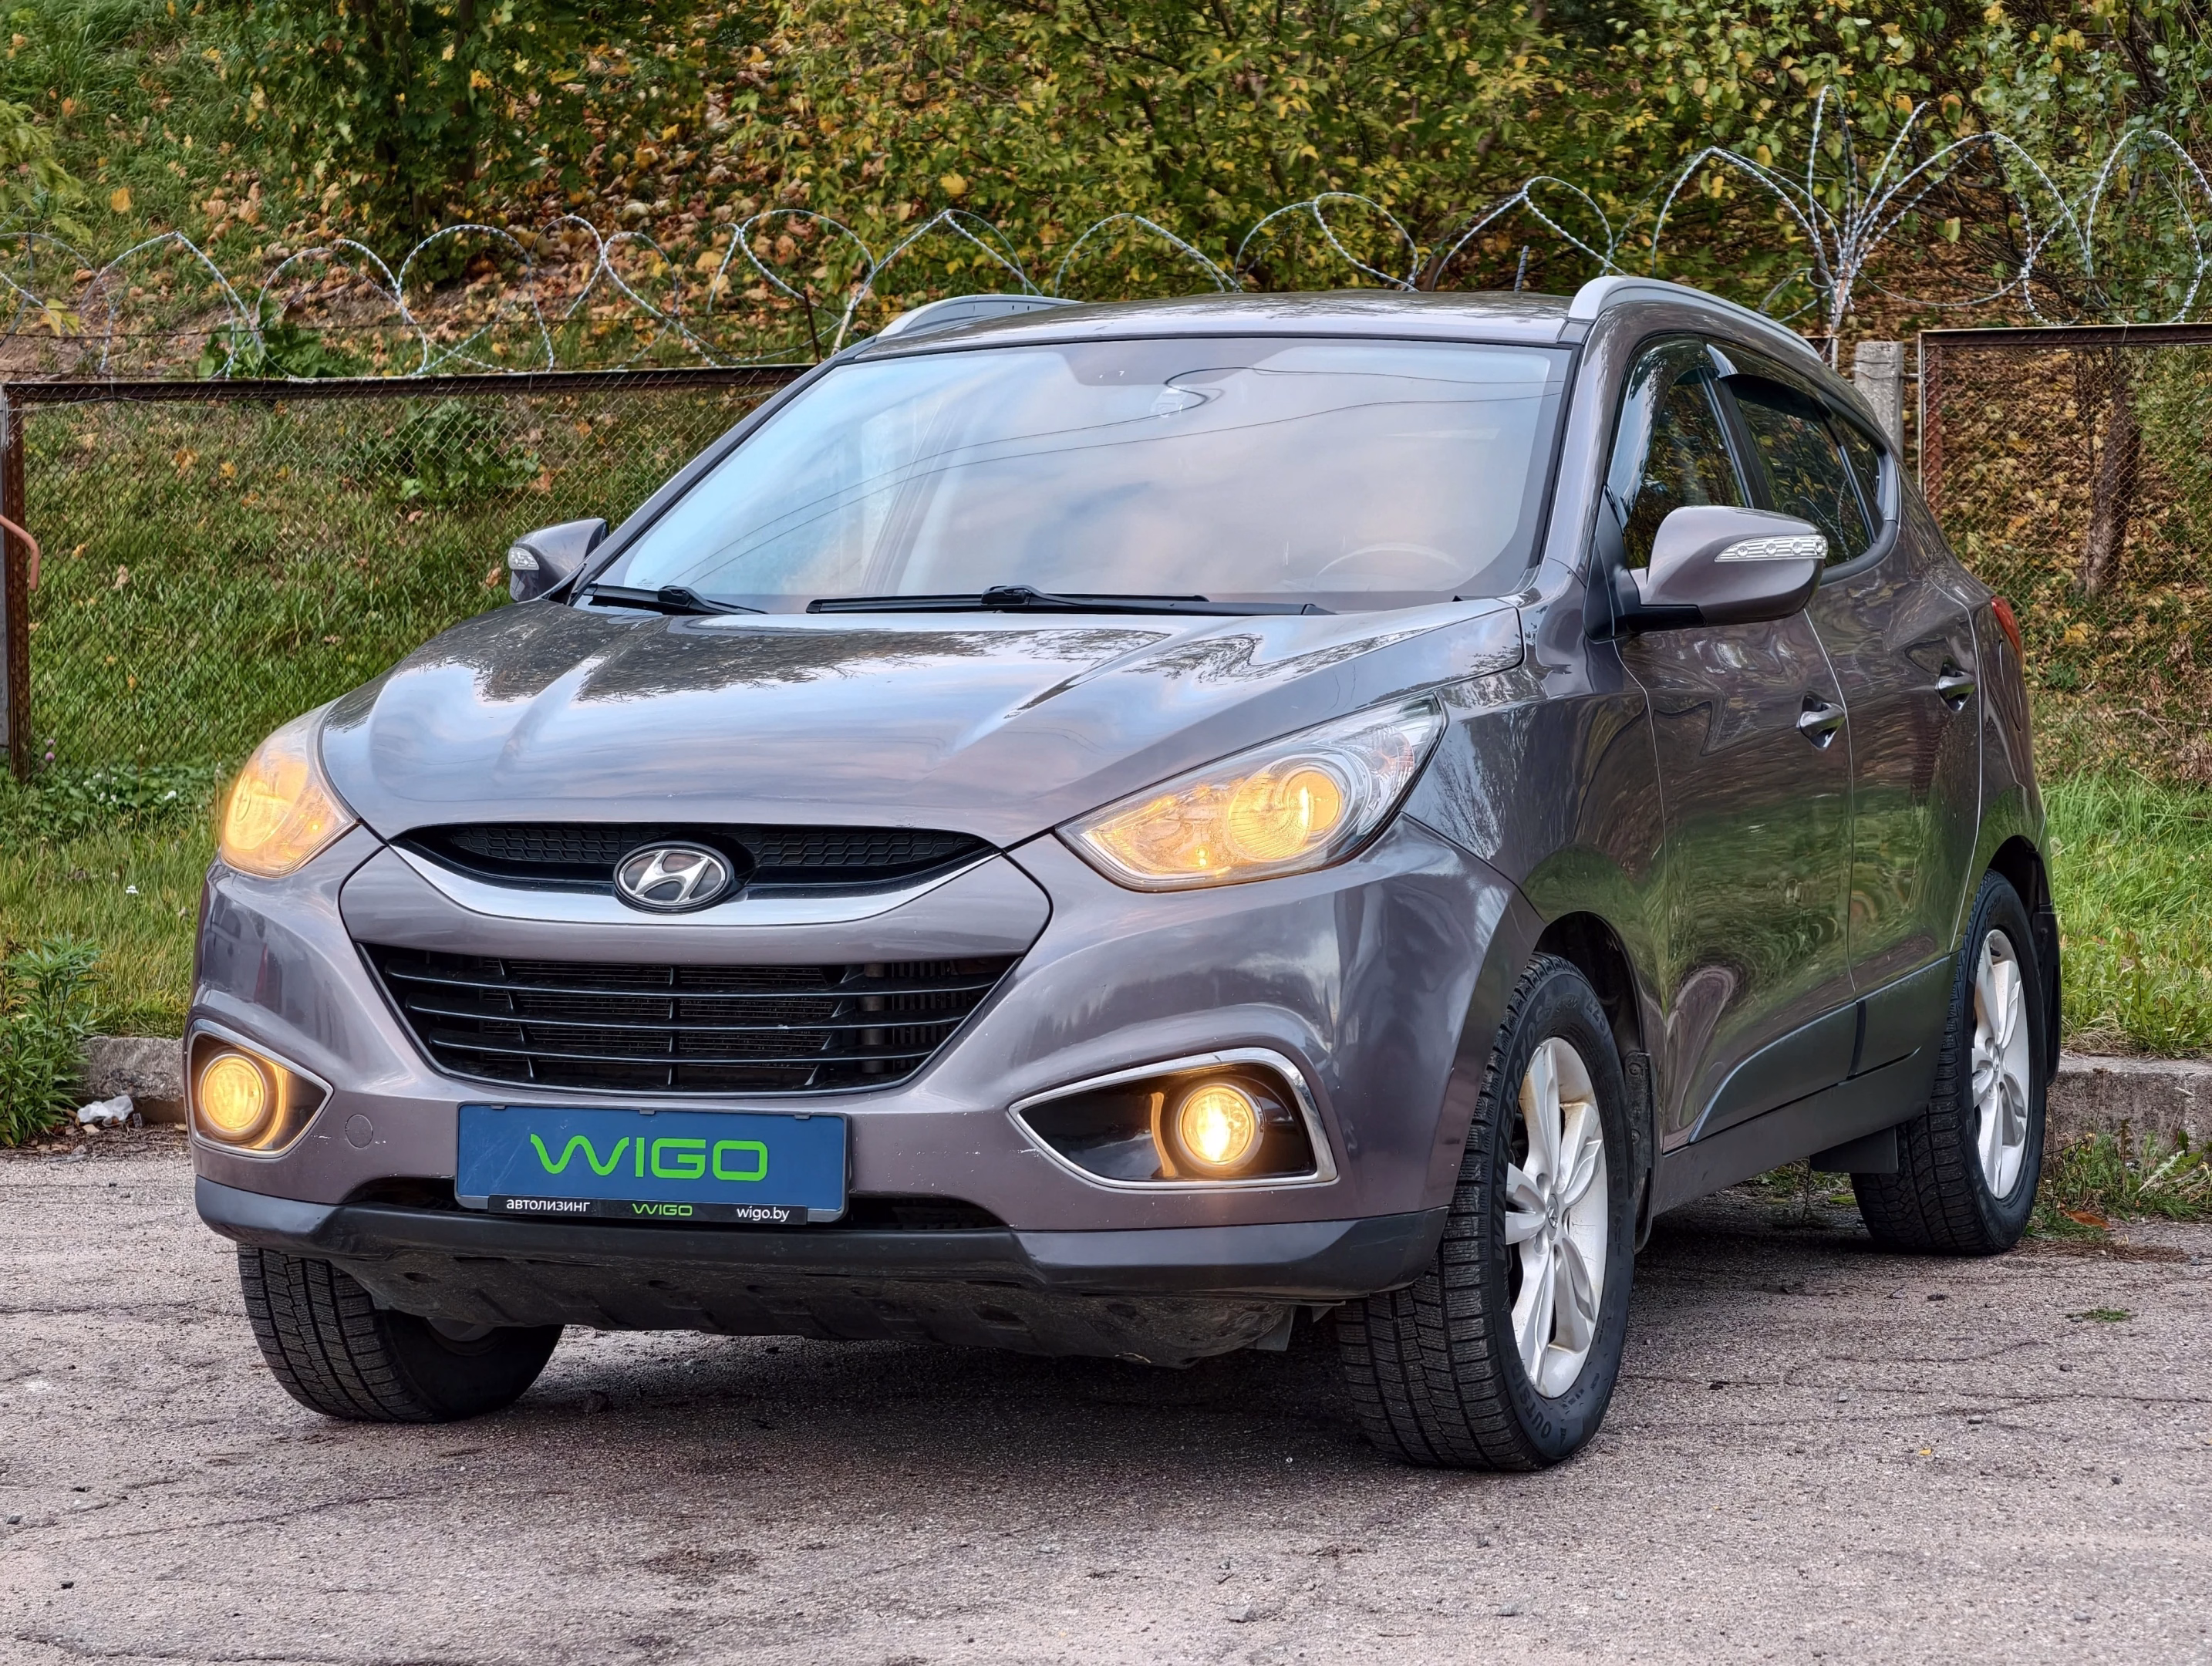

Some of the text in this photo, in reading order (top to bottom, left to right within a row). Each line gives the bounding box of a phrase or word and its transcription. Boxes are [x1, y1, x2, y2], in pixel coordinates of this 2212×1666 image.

[530, 1134, 768, 1182] WIGO
[506, 1198, 591, 1212] автолизинг
[632, 1203, 693, 1216] WIGO
[737, 1206, 790, 1223] wigo.by
